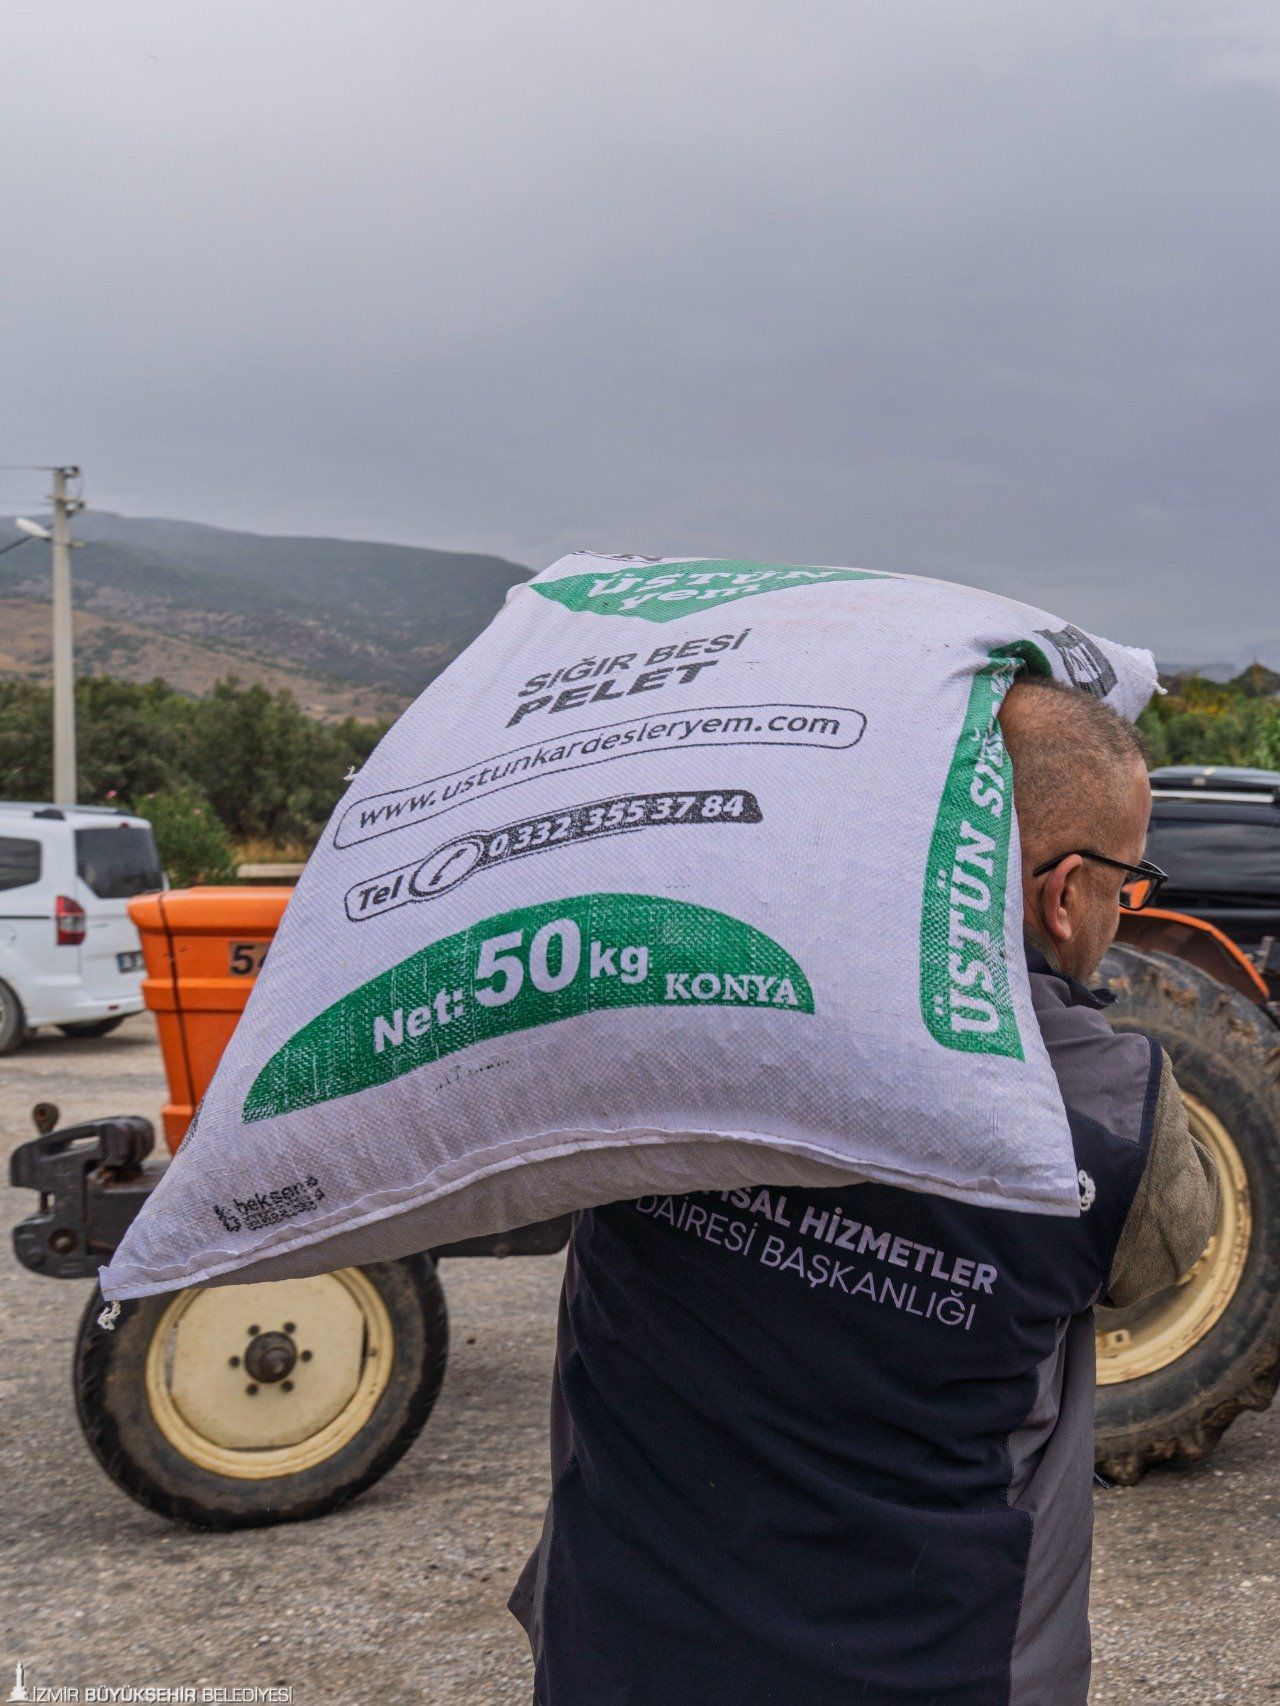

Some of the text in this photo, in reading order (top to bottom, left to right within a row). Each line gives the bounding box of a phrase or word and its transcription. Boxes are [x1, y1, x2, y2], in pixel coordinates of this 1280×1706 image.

[588, 570, 839, 598] ÜSTÜN
[504, 660, 719, 729] PELET
[517, 628, 753, 697] SIĞIR BESİ
[360, 713, 840, 829] www.ustunkardesleryem.com
[359, 874, 404, 911] Tel
[934, 820, 1000, 1034] ÜSTÜN
[229, 944, 270, 975] 5
[372, 919, 648, 1053] Net: 50 kg
[665, 974, 799, 1005] KONYA
[635, 1194, 977, 1331] DAİRESİ BAŞKANLIĞI
[702, 1186, 998, 1294] SAL HİZMETLER
